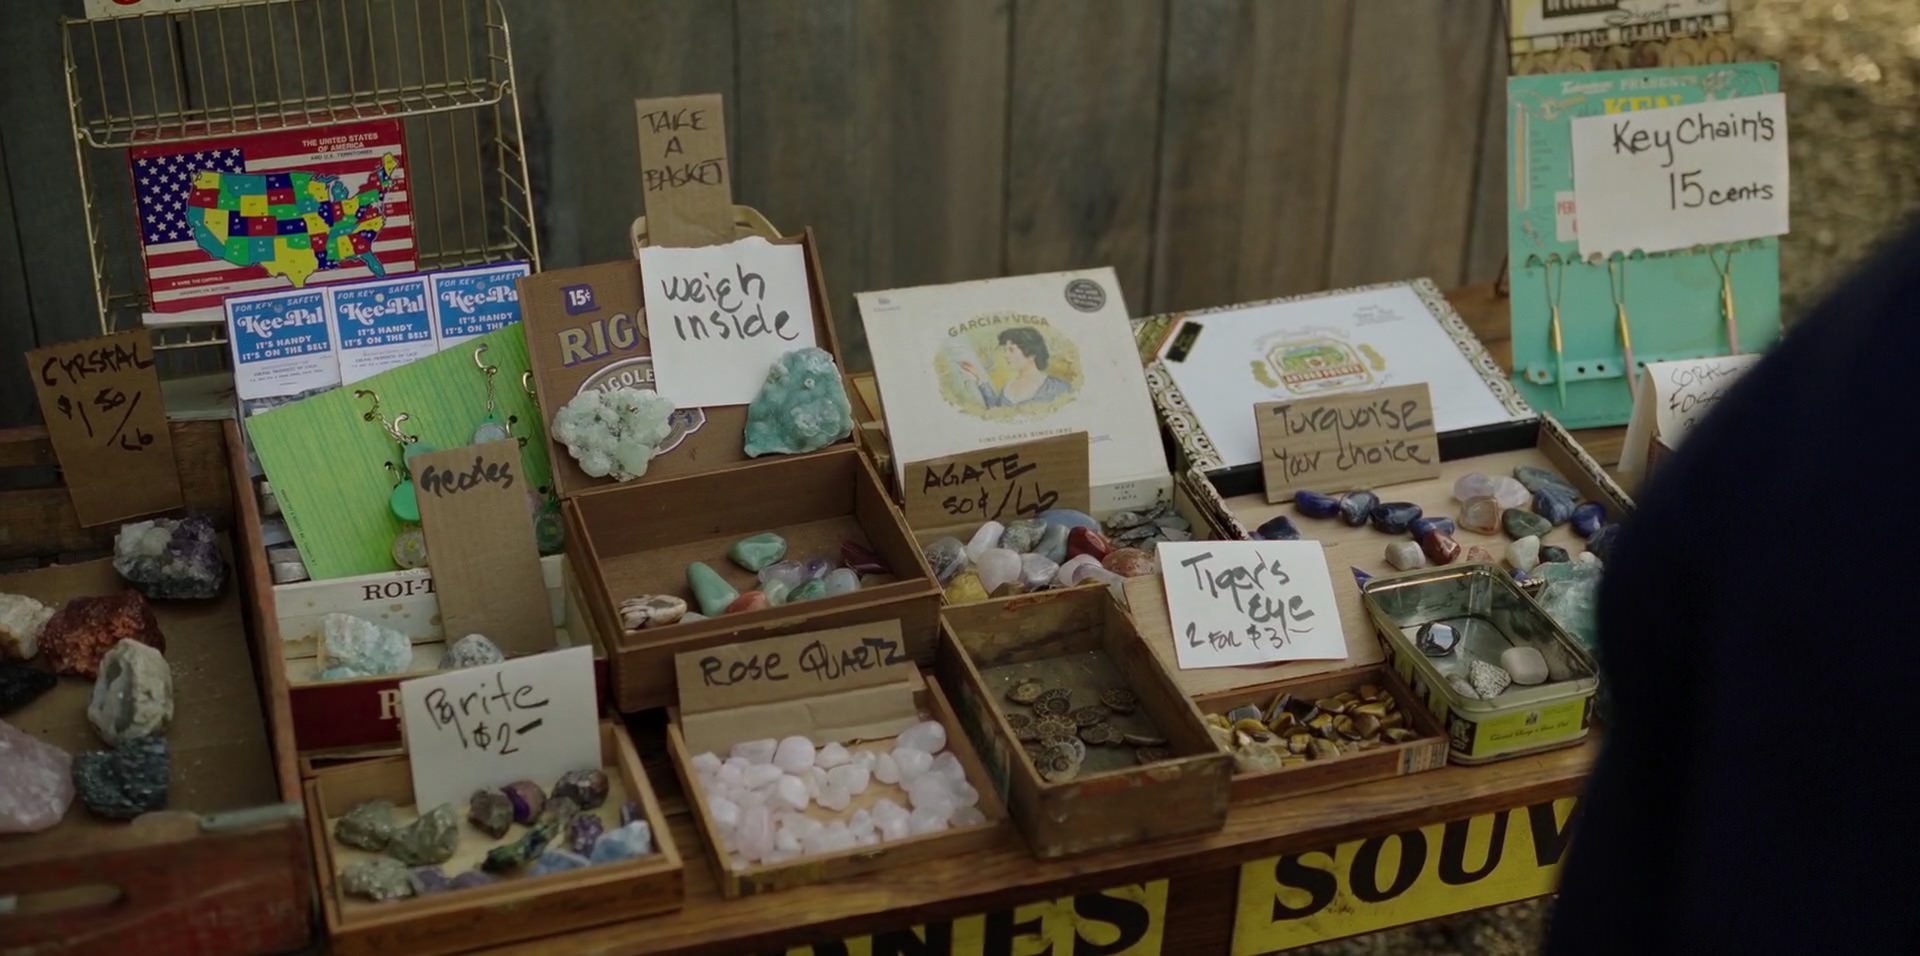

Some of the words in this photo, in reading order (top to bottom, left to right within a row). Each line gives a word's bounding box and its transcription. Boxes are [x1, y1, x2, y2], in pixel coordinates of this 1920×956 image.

[641, 108, 707, 134] TAKE
[301, 139, 317, 148] THE
[319, 136, 347, 146] UNITED
[348, 132, 379, 142] STATES
[317, 145, 330, 153] OF
[330, 142, 365, 152] AMERICA
[664, 136, 684, 158] A
[643, 158, 725, 191] BASKET
[1670, 170, 1704, 210] 15
[1708, 182, 1774, 206] cents
[439, 279, 456, 288] FOR
[459, 276, 475, 286] KEY
[489, 271, 522, 283] SAFETY
[337, 291, 355, 300] FOR
[357, 289, 375, 298] KEY
[388, 283, 421, 294] SAFETY
[440, 285, 519, 314] Kee-Pa
[568, 288, 592, 307] 15¢
[235, 304, 251, 313] FOR
[256, 301, 273, 311] KEY
[287, 295, 320, 306] SAFETY
[339, 294, 425, 326] Kee-Pal
[237, 307, 325, 338] Kee-Pal
[459, 315, 477, 324] IT'S
[479, 312, 513, 323] HANDY
[948, 314, 1002, 337] GARCIA
[1013, 313, 1050, 328] VEGA
[344, 338, 362, 347] IT'S
[366, 335, 382, 345] ON
[386, 332, 404, 343] THE
[408, 330, 429, 340] BELT
[357, 327, 376, 337] IT'S
[378, 323, 413, 334] HANDY
[445, 326, 463, 336] IT'S
[467, 323, 483, 333] ON
[242, 351, 261, 361] IT'S
[264, 348, 281, 357] ON
[284, 345, 303, 355] THE
[306, 342, 328, 352] BELT
[256, 340, 274, 350] IT'S
[276, 335, 312, 347] HANDY
[1273, 399, 1433, 447] Turquoise
[1336, 440, 1431, 471] choice
[923, 453, 1036, 495] AGATE
[1186, 622, 1205, 648] 2
[799, 638, 909, 682] QUARTZ
